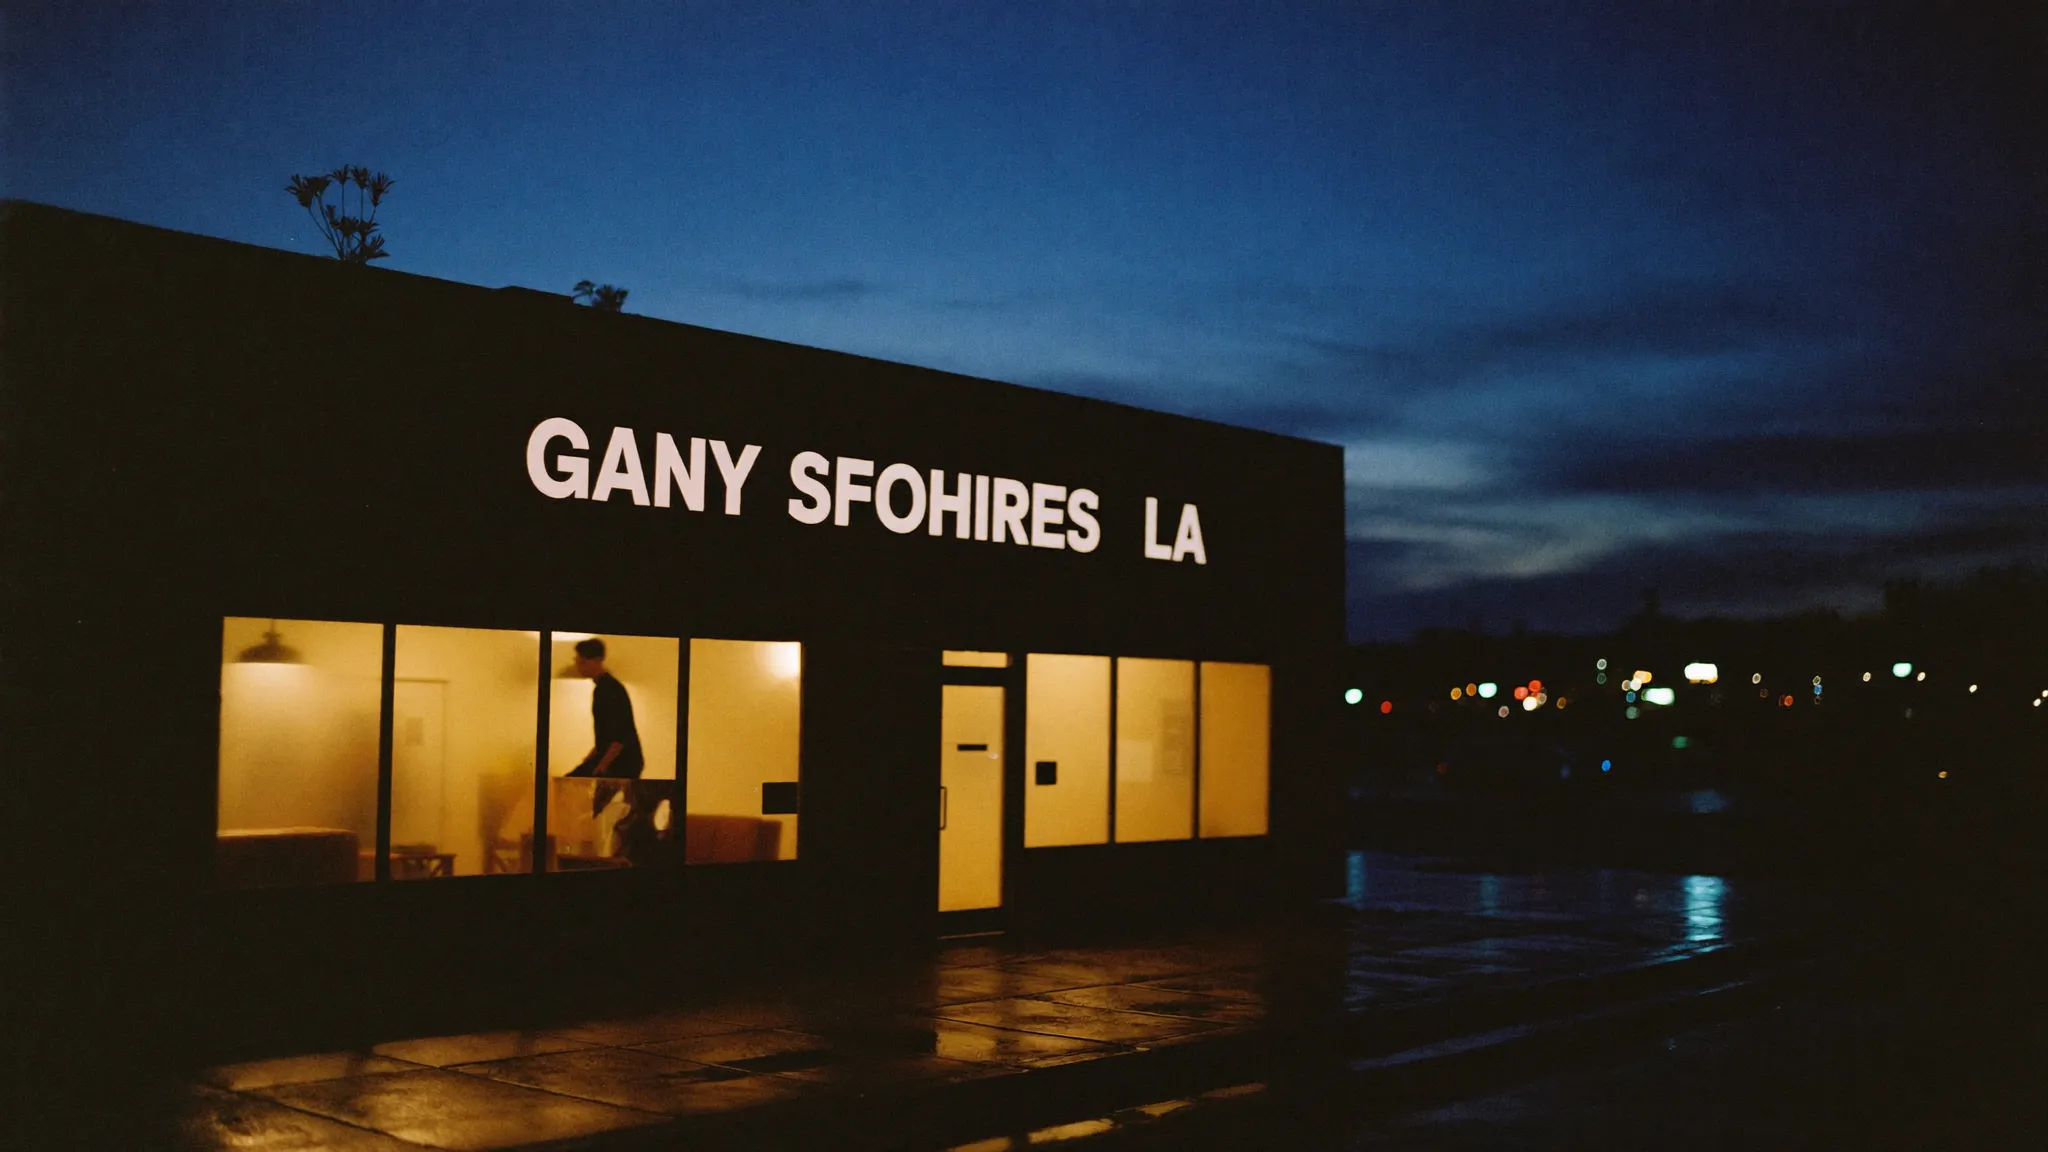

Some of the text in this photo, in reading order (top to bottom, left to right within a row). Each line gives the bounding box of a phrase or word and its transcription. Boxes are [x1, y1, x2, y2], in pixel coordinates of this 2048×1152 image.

[526, 417, 1207, 565] GANY SFOHIRES LA
